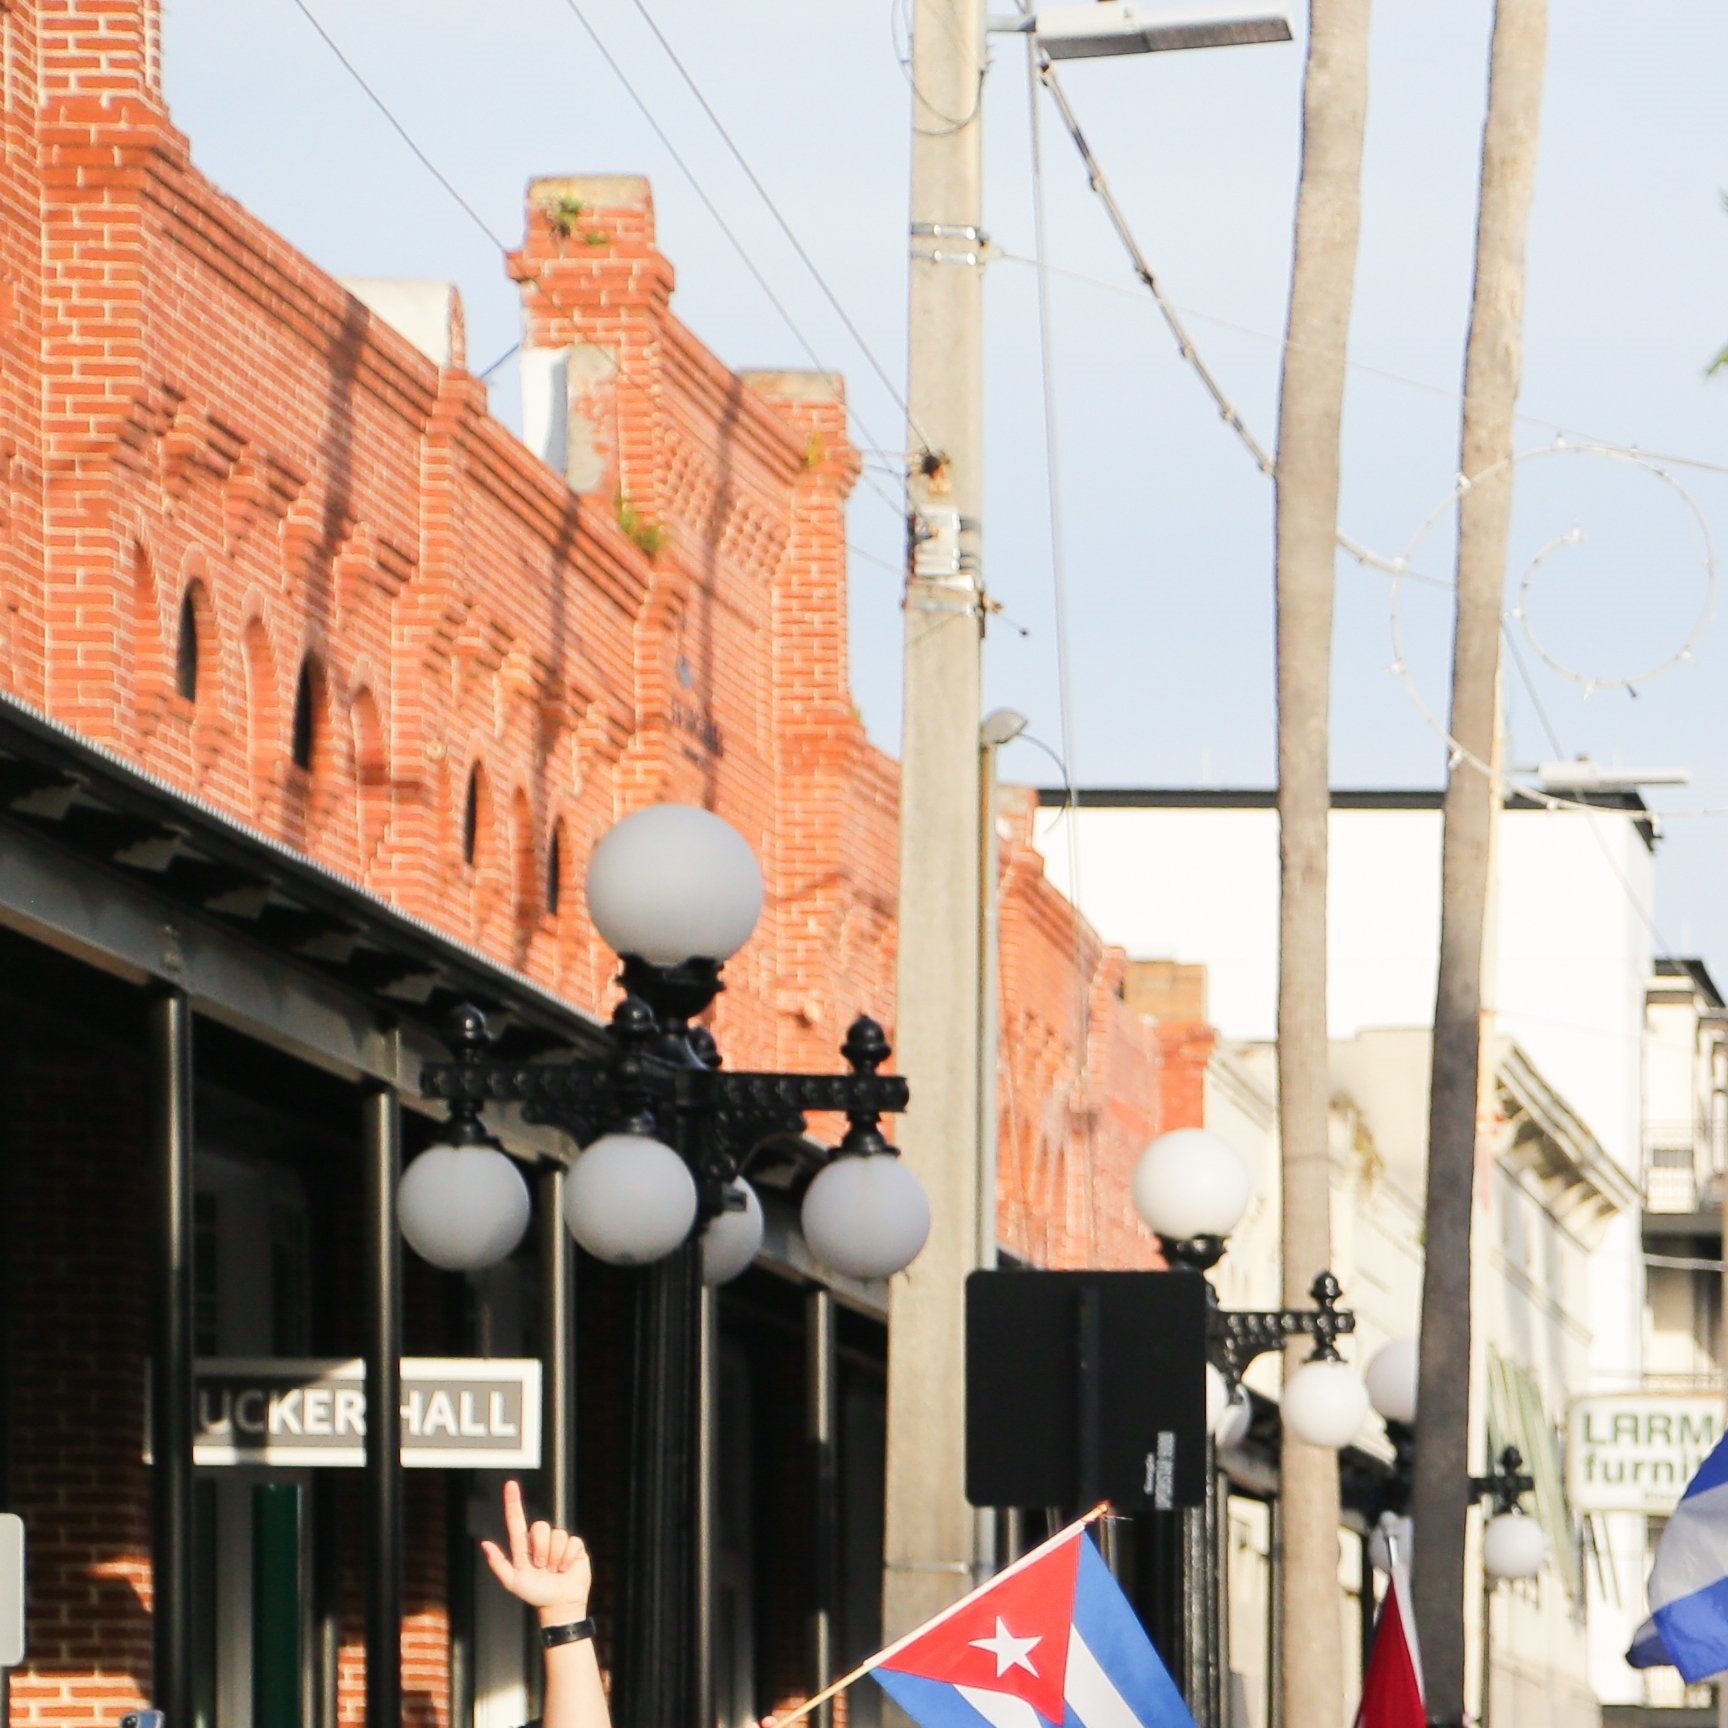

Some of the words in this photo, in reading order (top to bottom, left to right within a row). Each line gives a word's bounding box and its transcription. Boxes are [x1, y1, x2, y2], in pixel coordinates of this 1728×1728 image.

[200, 1387, 366, 1435] UCKER
[400, 1388, 518, 1438] HALL
[1584, 1413, 1714, 1445] LARM
[1586, 1451, 1702, 1484] furni
